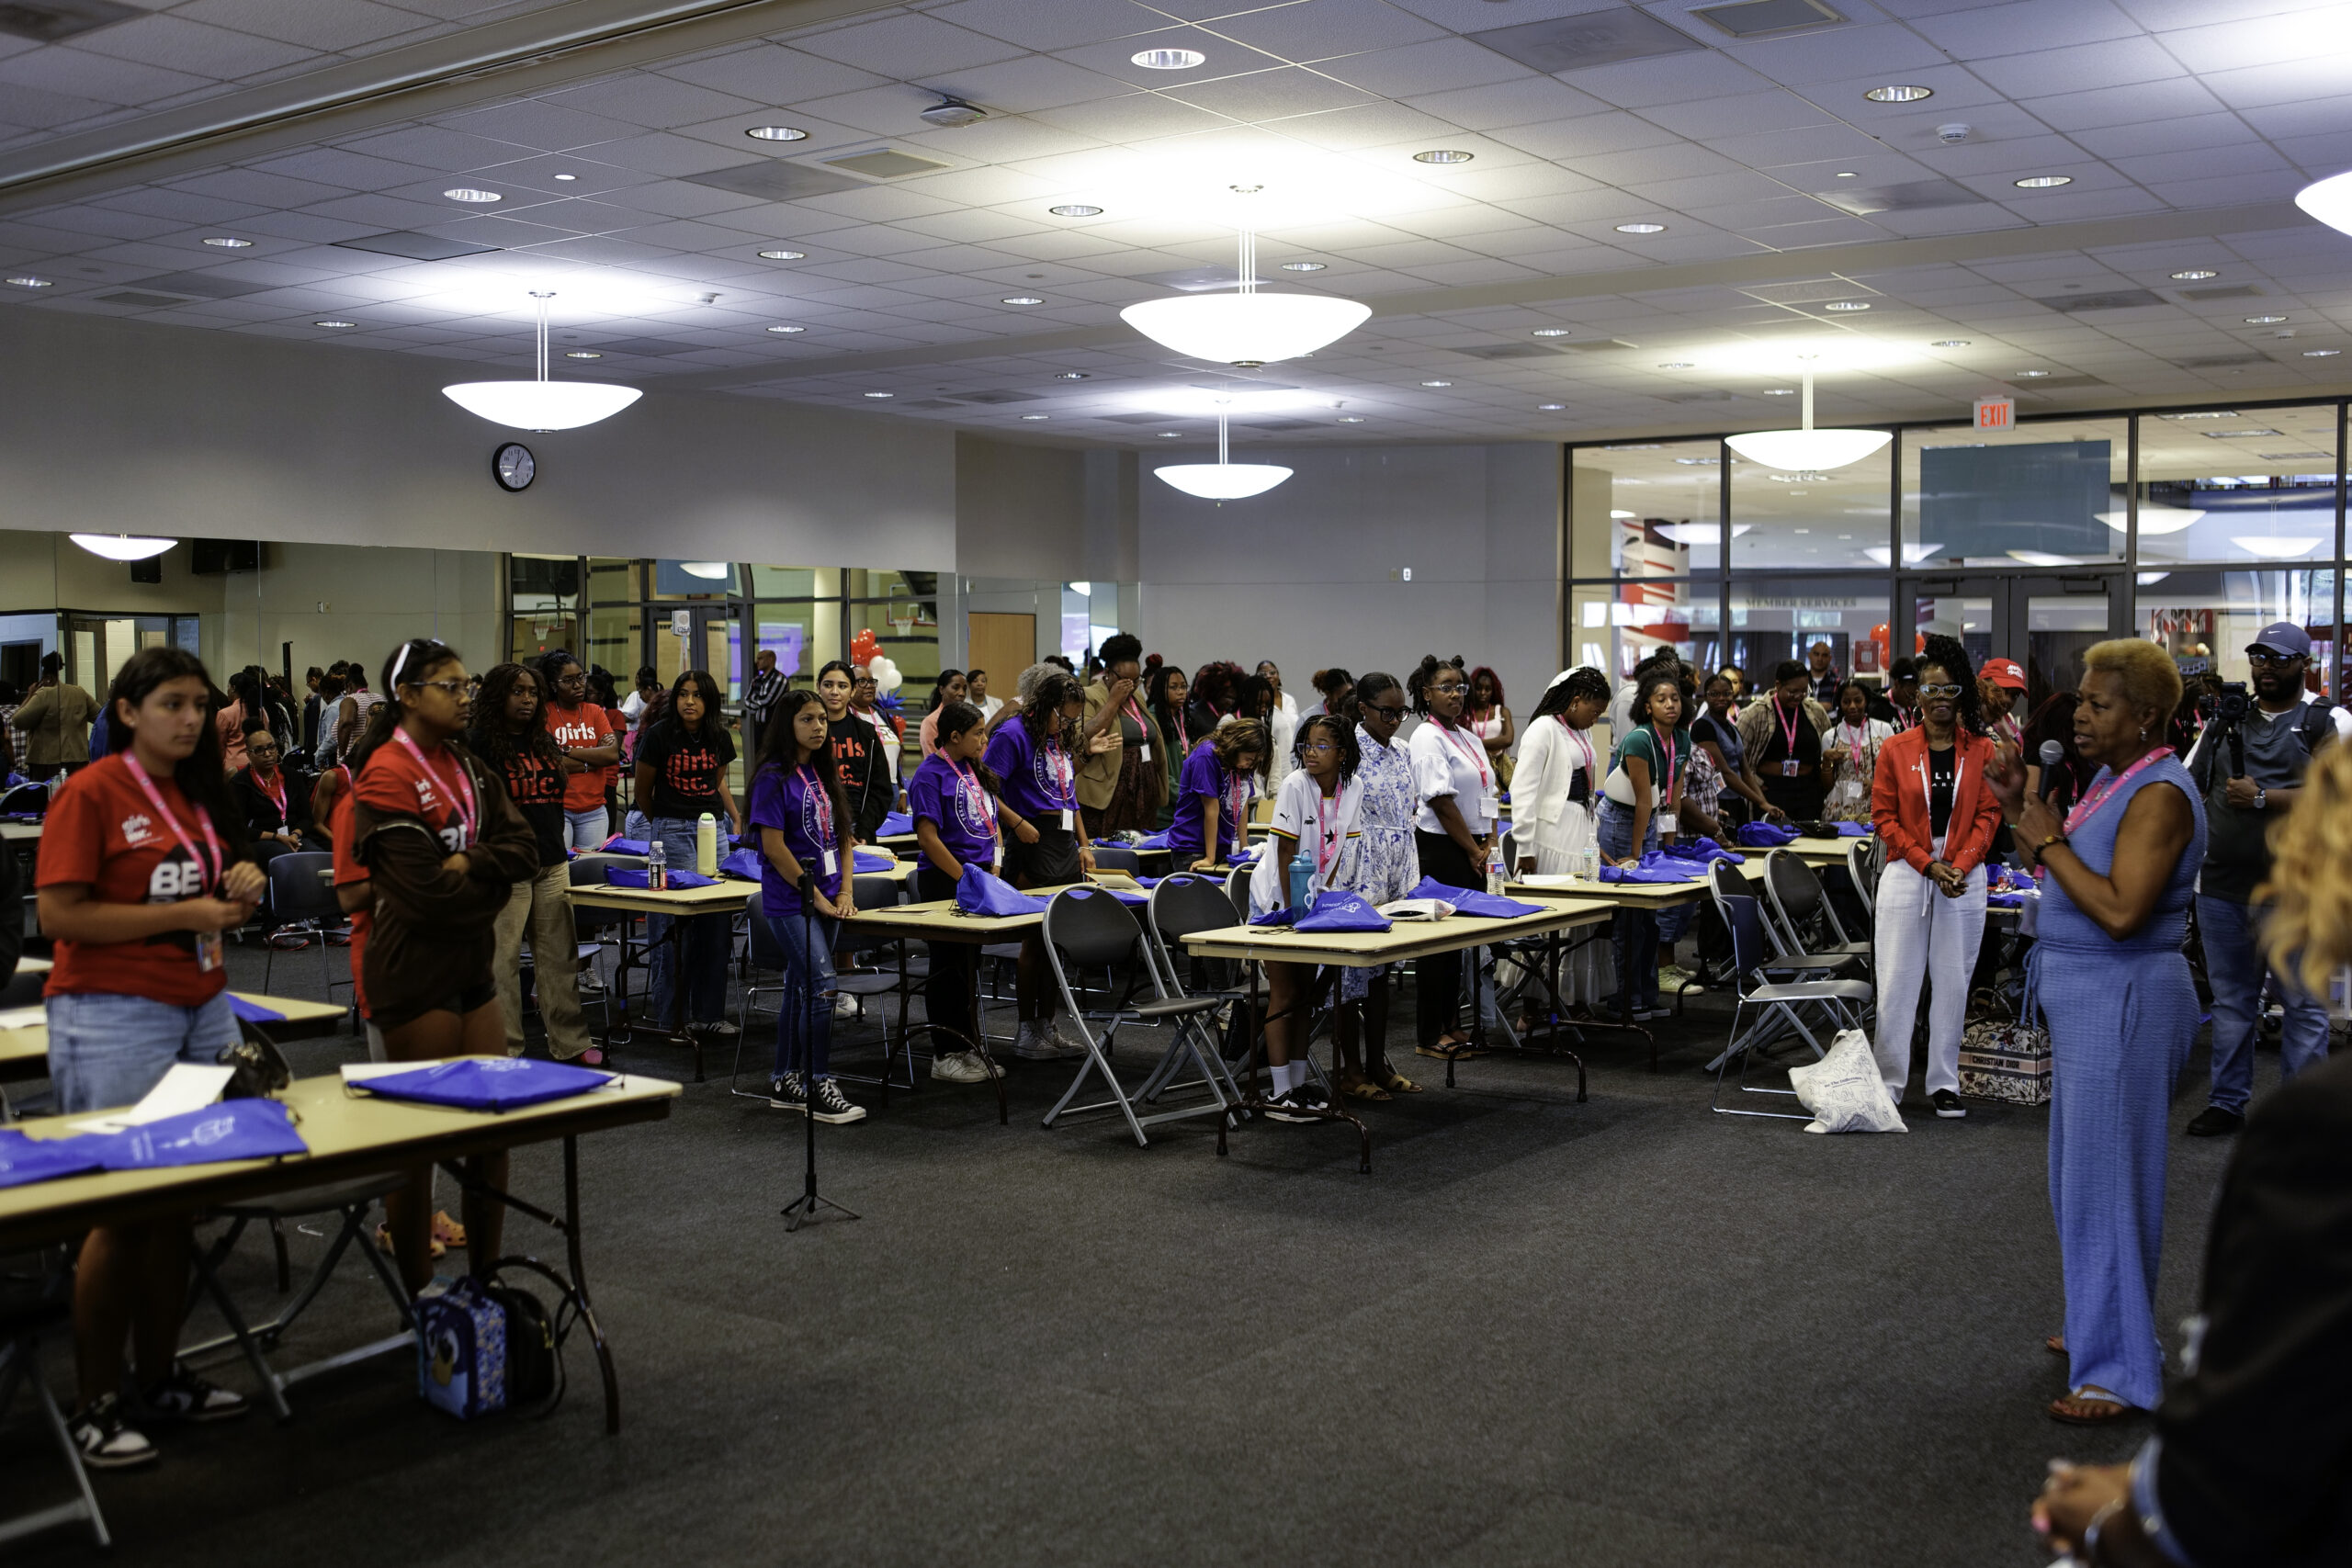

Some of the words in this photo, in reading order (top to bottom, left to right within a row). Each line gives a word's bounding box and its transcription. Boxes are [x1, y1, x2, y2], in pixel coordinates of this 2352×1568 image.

[1980, 403, 2009, 427] EXIT
[1746, 597, 1797, 607] MEMBER
[1801, 597, 1857, 607] SERVICES
[555, 722, 596, 745] girls
[830, 736, 865, 759] irls
[666, 748, 718, 775] girls
[508, 773, 560, 797] inc.
[958, 801, 967, 821] TEXAS
[1972, 1055, 2003, 1066] CHRISTIAN
[2007, 1059, 2020, 1068] DIOR
